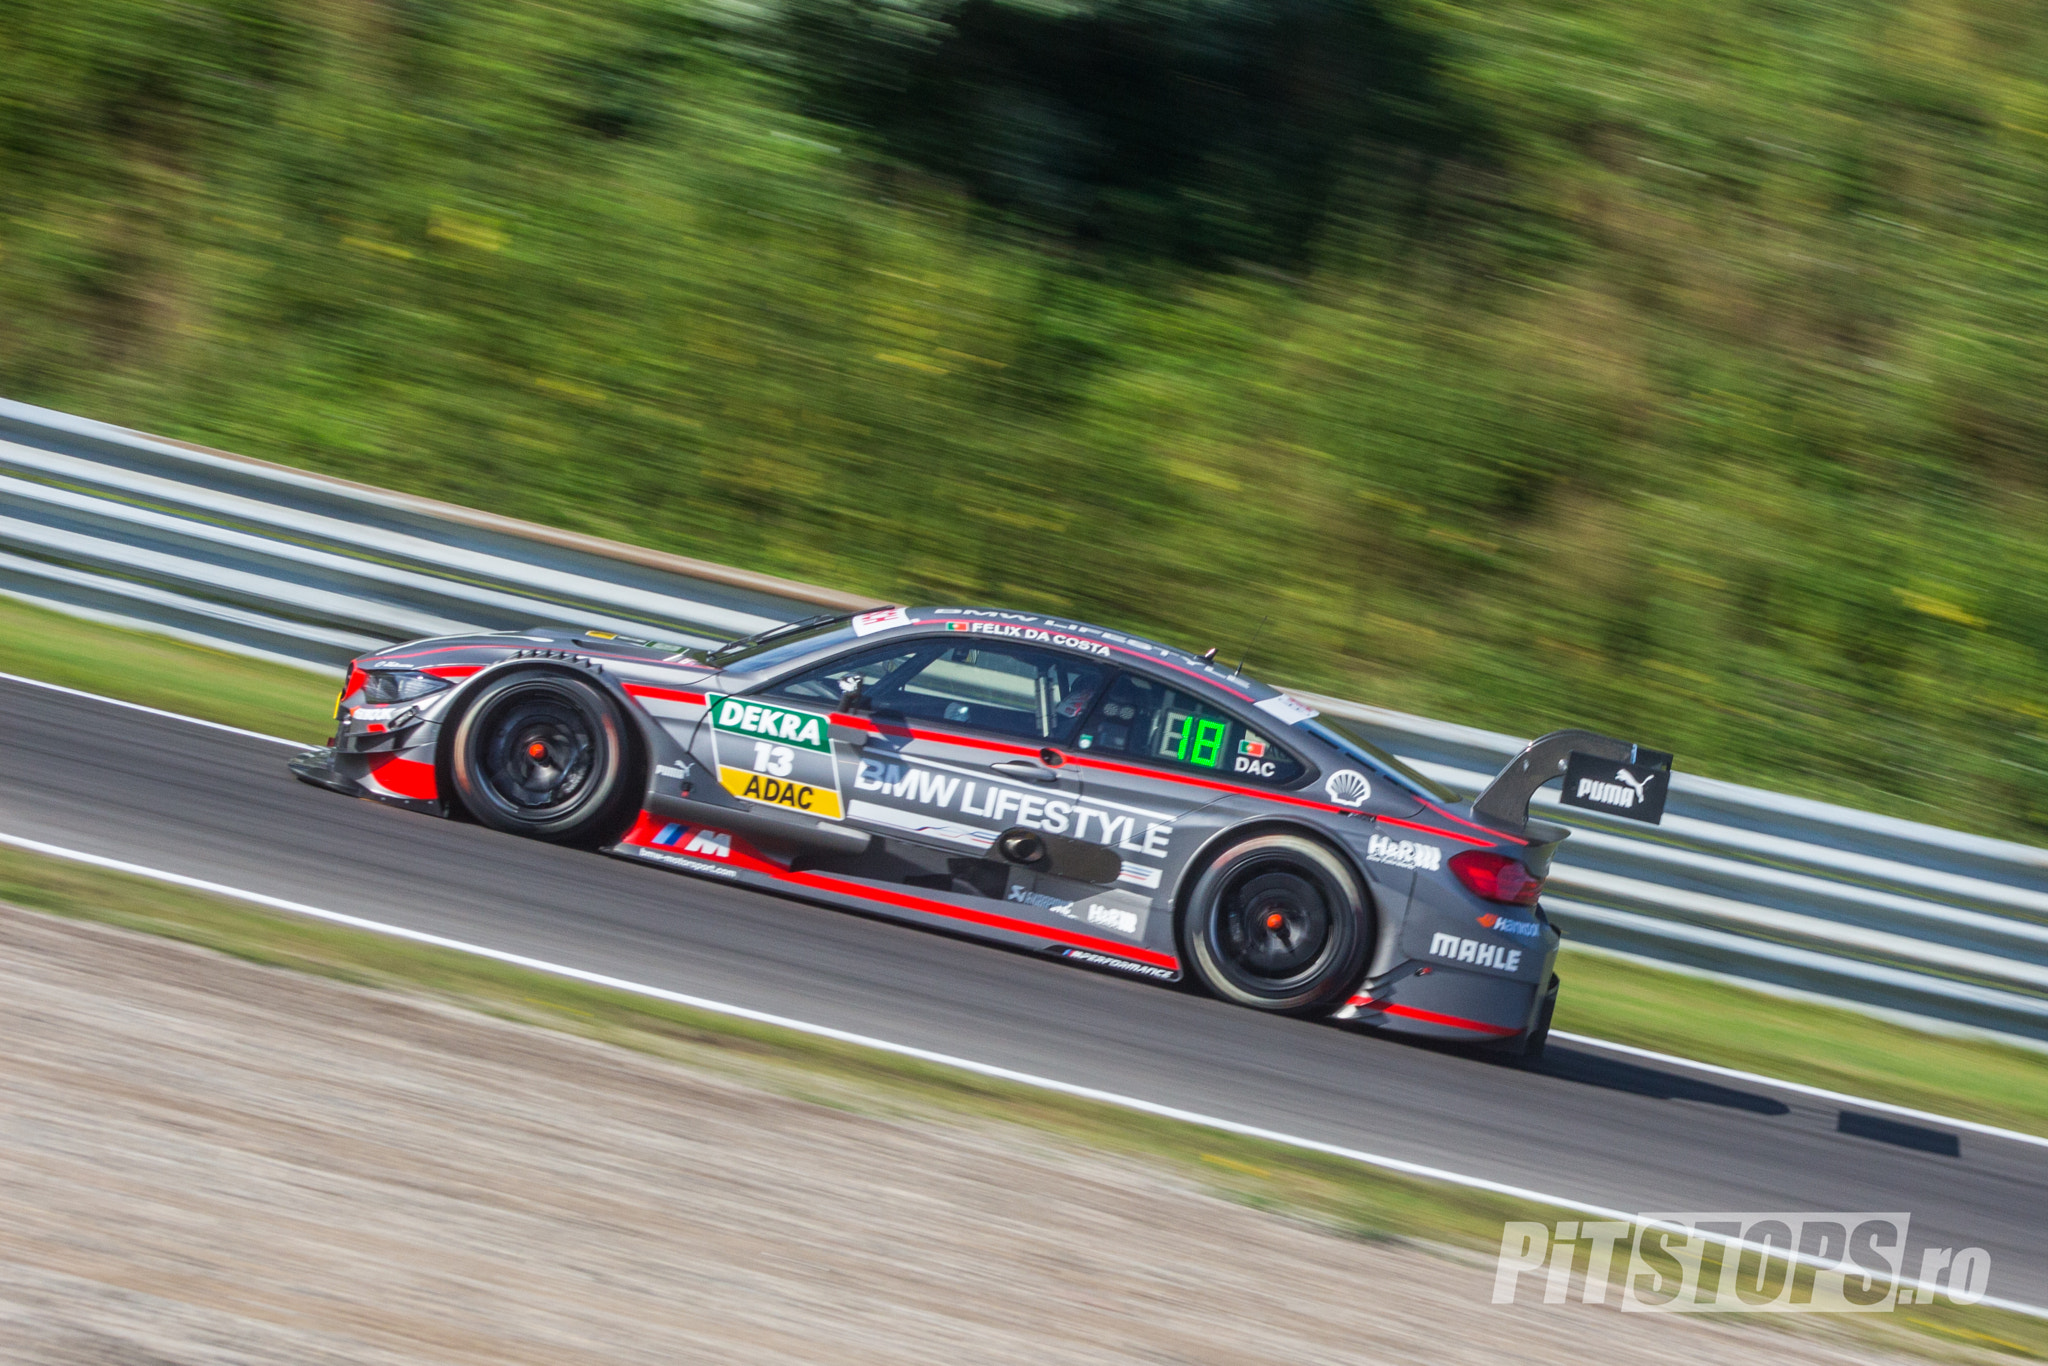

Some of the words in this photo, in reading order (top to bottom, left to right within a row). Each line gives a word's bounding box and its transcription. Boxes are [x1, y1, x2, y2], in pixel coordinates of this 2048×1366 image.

[1024, 628, 1050, 643] DA
[1053, 634, 1111, 657] COSTA
[718, 700, 821, 746] DEKRA
[753, 741, 795, 777] 13
[1234, 757, 1276, 777] DAC
[743, 775, 813, 810] ADAC
[853, 757, 961, 808] BMW
[960, 781, 1174, 858] LIFESTYLE
[1576, 777, 1635, 808] PUMA
[684, 829, 732, 858] M
[1429, 932, 1523, 972] MAHLE
